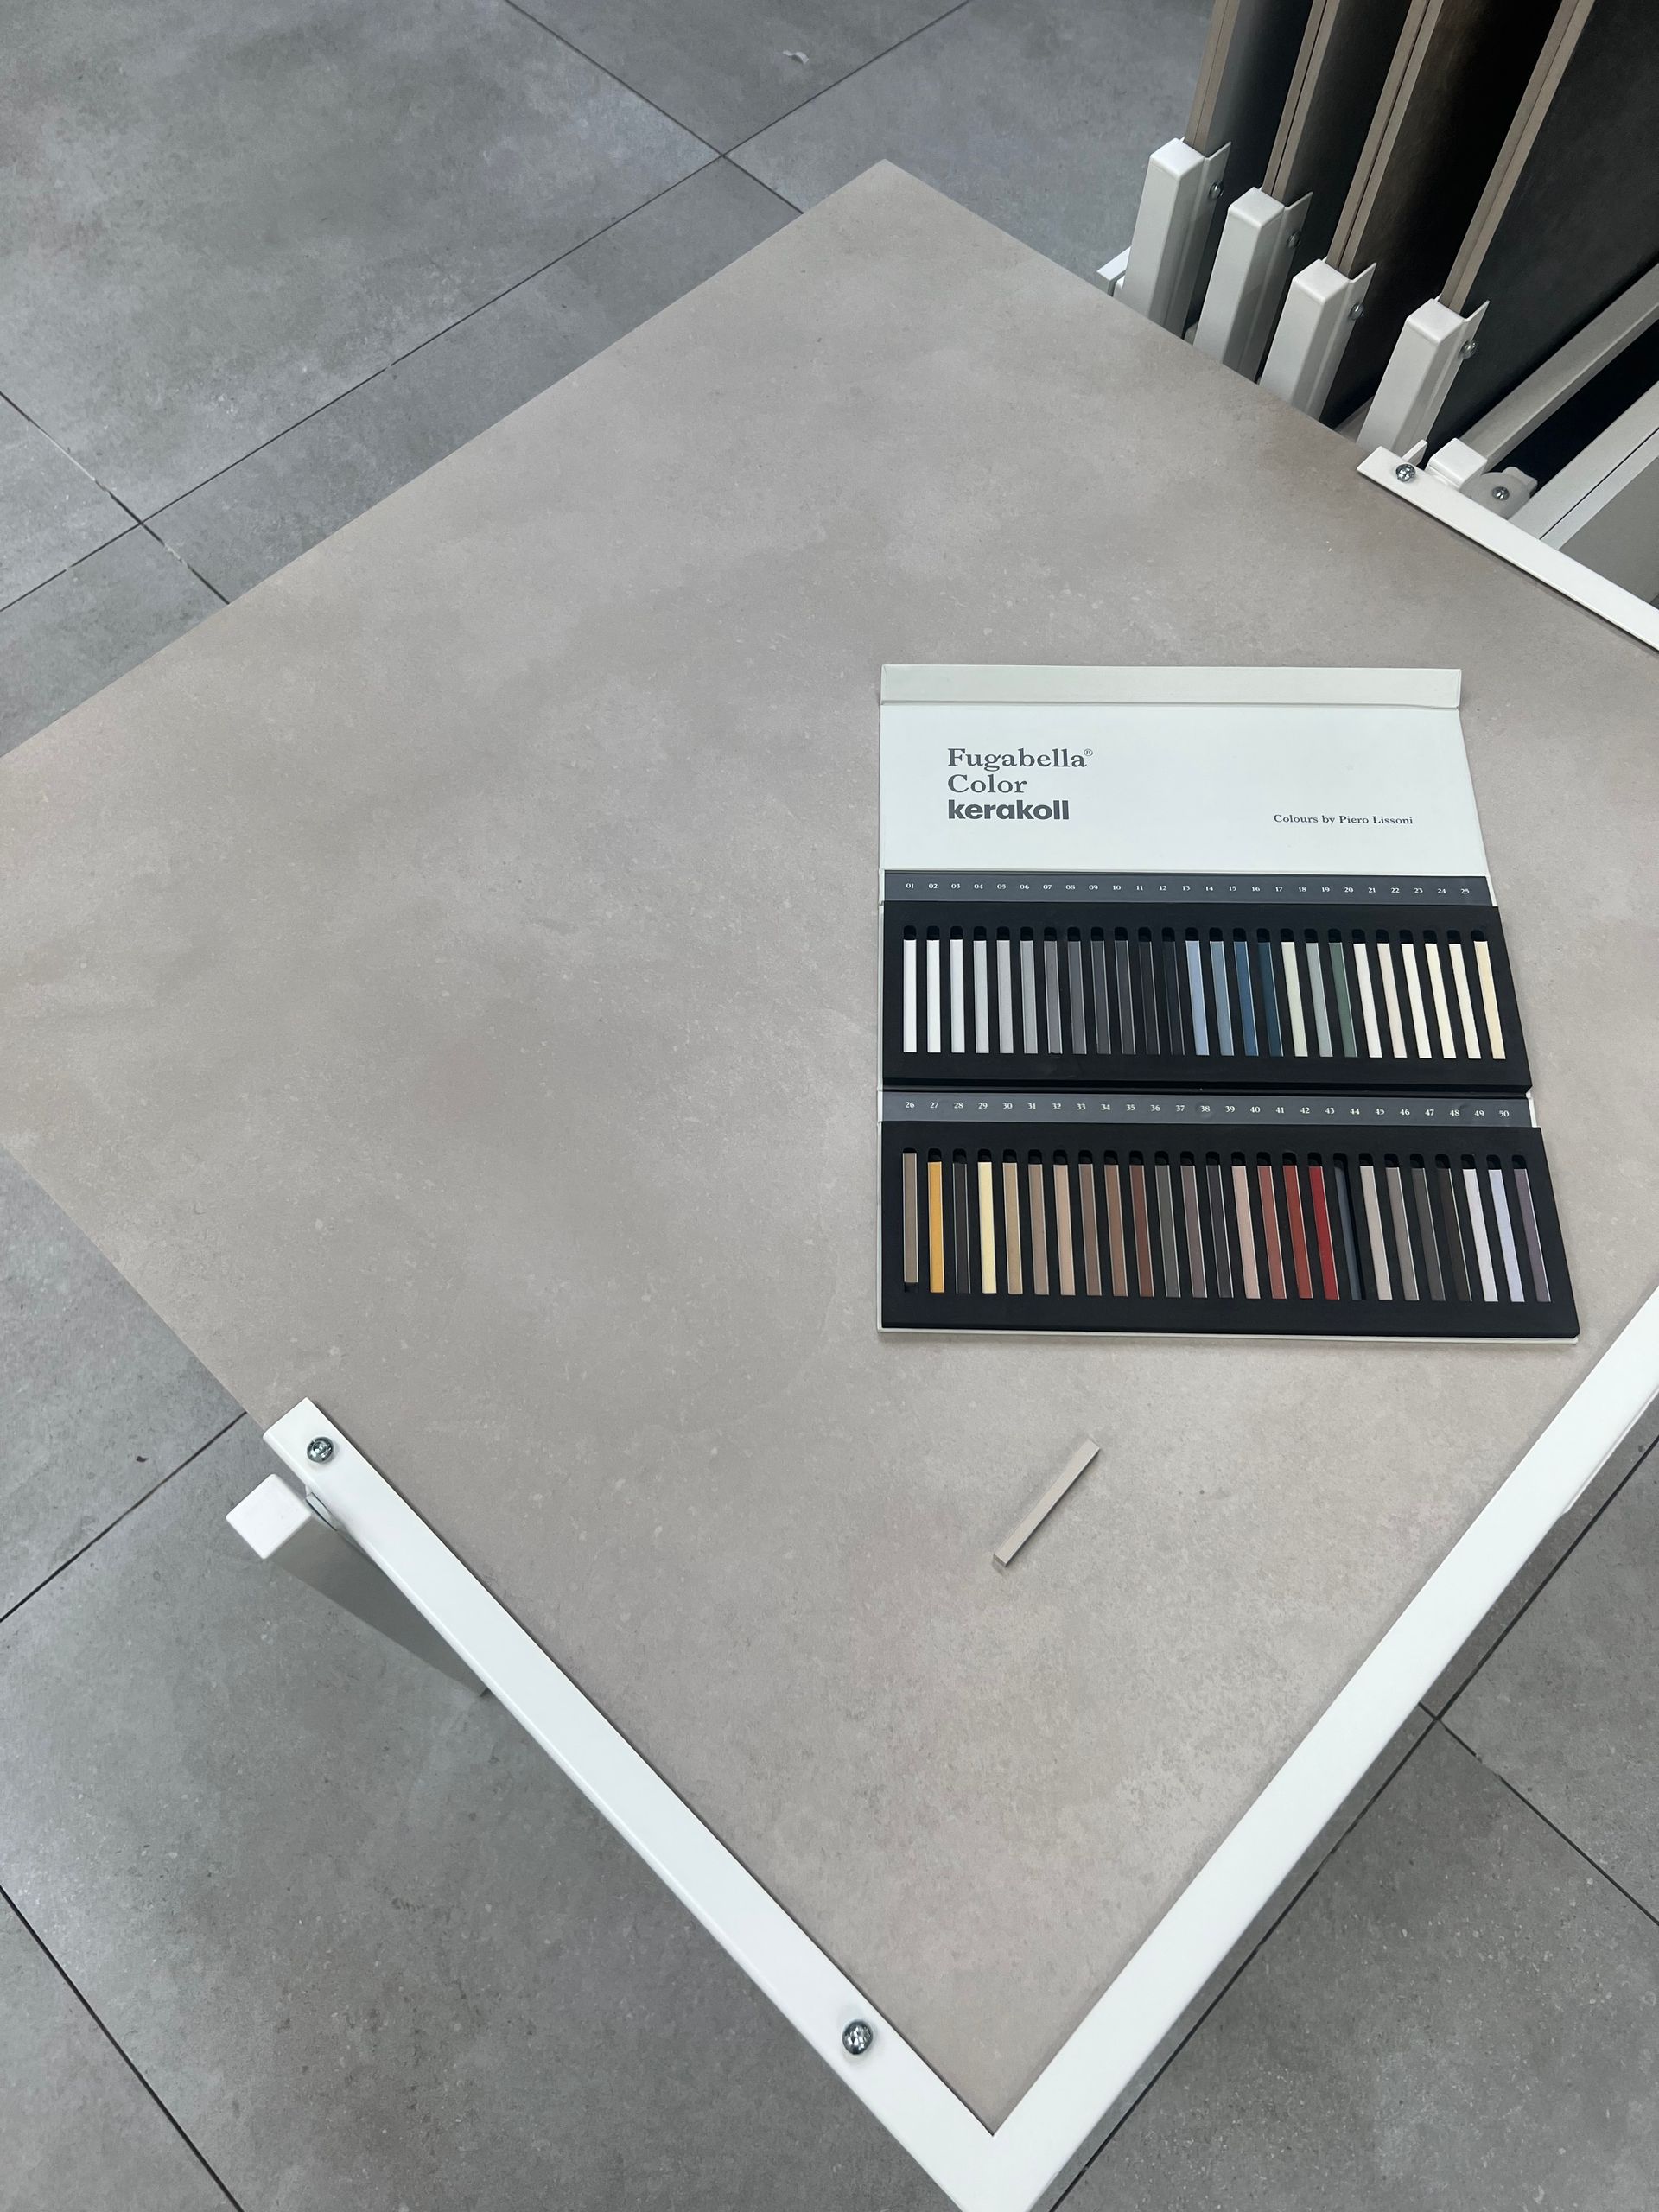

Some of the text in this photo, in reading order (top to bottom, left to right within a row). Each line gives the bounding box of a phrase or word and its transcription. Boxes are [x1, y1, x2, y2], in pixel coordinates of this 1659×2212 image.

[947, 773, 1027, 794] Color
[948, 798, 1070, 821] kerakoll
[1273, 814, 1414, 825] Colours by Piero Lissoni
[1077, 1103, 1086, 1111] 33
[1300, 1106, 1311, 1115] 42
[1399, 1108, 1411, 1116] 46
[1449, 1109, 1460, 1117] 48
